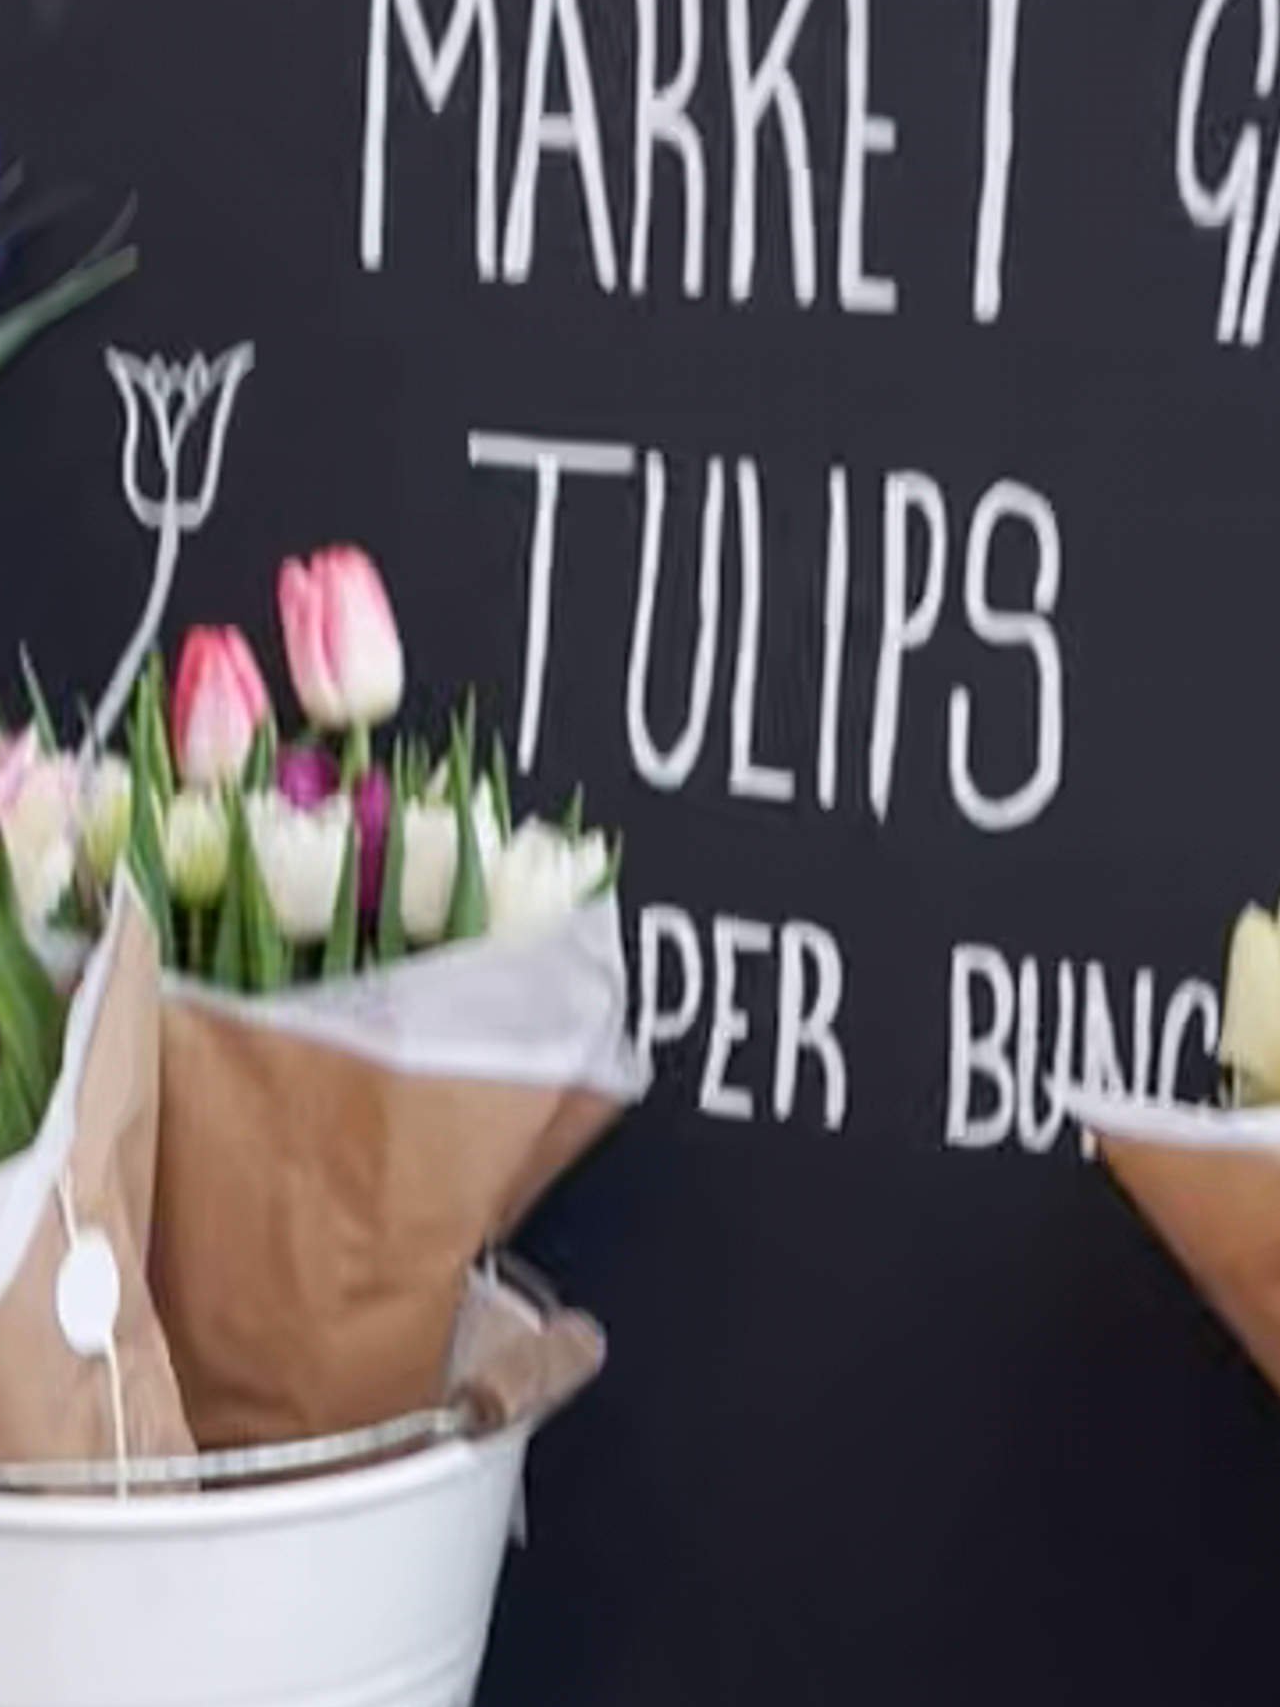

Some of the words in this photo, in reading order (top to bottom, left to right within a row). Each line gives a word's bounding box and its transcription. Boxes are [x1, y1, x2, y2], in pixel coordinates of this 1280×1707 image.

[468, 429, 1064, 831] TULIPS
[635, 901, 846, 1133] PER
[946, 941, 1234, 1161] BUNC
